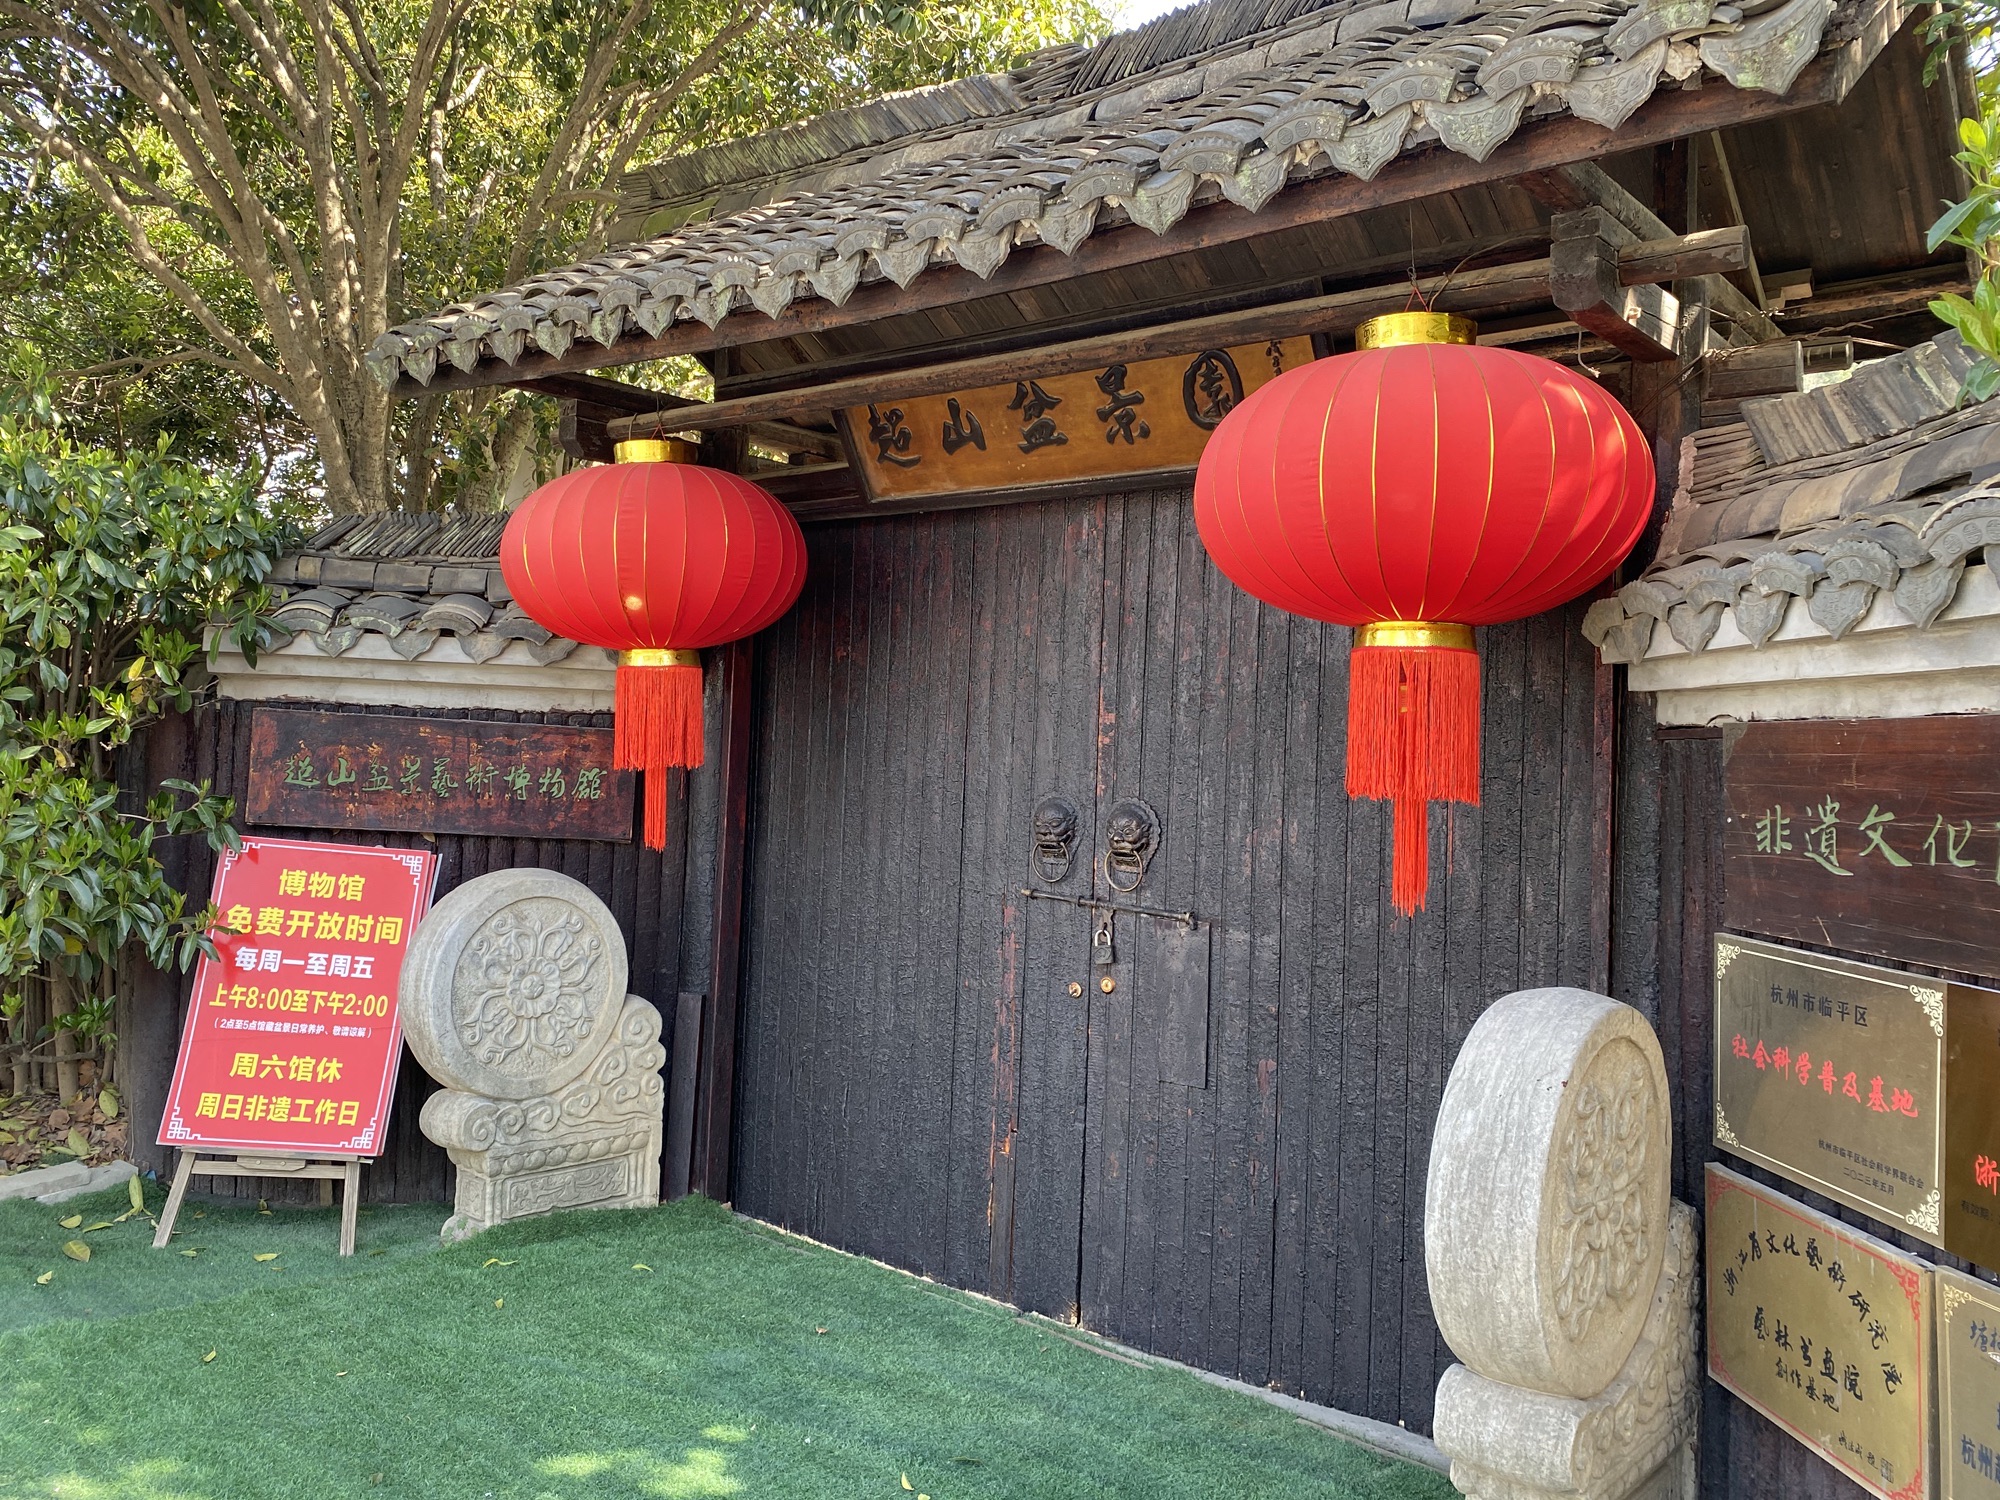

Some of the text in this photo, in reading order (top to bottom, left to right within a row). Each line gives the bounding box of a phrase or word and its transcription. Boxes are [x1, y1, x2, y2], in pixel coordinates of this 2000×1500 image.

[1756, 794, 2000, 886] 非遺文化
[279, 869, 366, 902] 博物馆
[226, 904, 403, 945] 免费开放时间
[235, 946, 375, 979] 每周一至周五
[209, 983, 388, 1017] 上午8:00至下午2:00
[1770, 983, 1869, 1028] 杭州市临平区
[229, 1053, 343, 1083] 周六馆休
[1732, 1033, 1919, 1118] 社会科学普及基地
[195, 1093, 360, 1127] 周日非遗工作日
[1961, 1433, 2000, 1486] 杭州
